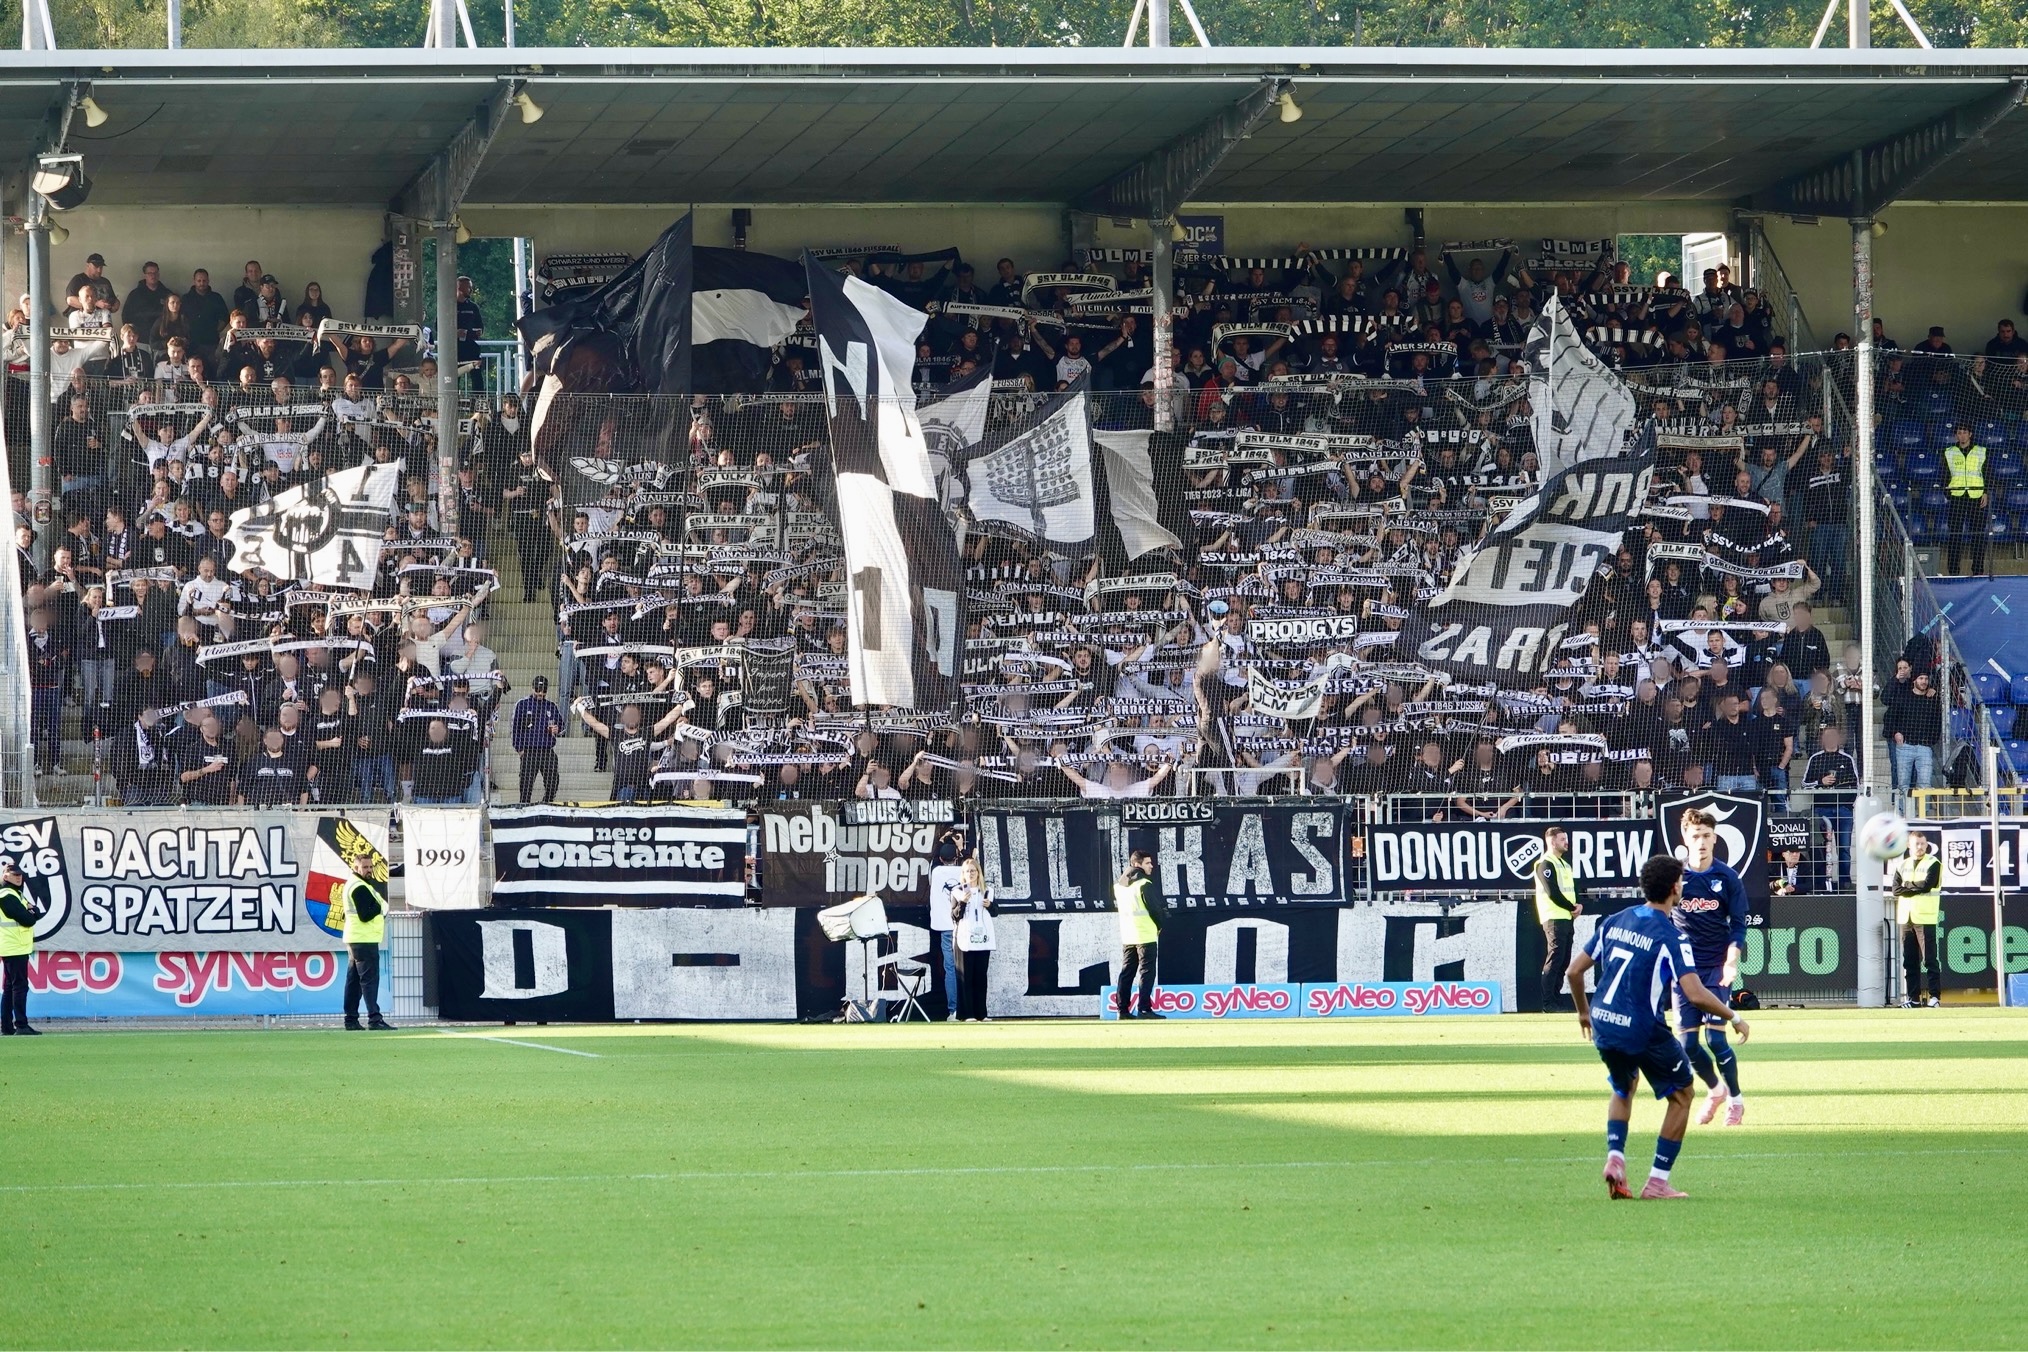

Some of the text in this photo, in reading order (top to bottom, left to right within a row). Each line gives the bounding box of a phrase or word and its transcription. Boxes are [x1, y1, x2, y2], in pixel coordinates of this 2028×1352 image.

[1091, 249, 1153, 261] ULME
[52, 327, 107, 337] ULM 1846
[338, 323, 410, 335] SSV ULM 1846
[1390, 343, 1415, 352] LMER
[237, 407, 252, 418] SSV
[253, 407, 271, 416] ULM
[291, 405, 329, 416] FUSSBALL
[1245, 435, 1320, 448] SSV ULM 1846
[1713, 533, 1733, 549] SSV
[1201, 550, 1296, 562] SSV ULM 1846
[346, 600, 373, 609] ULM
[1251, 617, 1356, 638] PRODIGYS
[1252, 675, 1319, 701] POWER
[1114, 704, 1163, 715] BROKEN
[1326, 720, 1436, 737] PRODIGYS
[846, 800, 954, 824] NOVUS IGNIS
[1124, 803, 1212, 820] PRODIGYS
[594, 825, 653, 842] nero
[1770, 823, 1806, 833] DONAU
[1772, 836, 1807, 846] STURM
[82, 826, 298, 880] BACHTAL
[415, 848, 466, 868] 1999
[517, 841, 726, 870] constante
[1375, 830, 1653, 881] DONAU REW
[826, 856, 931, 898] imper
[82, 884, 296, 936] SPATZEN
[1680, 898, 1720, 914] syNeo
[1606, 927, 1653, 952] AMAIMOUNI
[156, 951, 337, 1005] syNeo
[1602, 946, 1635, 1005] 7
[1203, 987, 1290, 1017] syNeo
[1309, 984, 1491, 1014] syNeo syNeo
